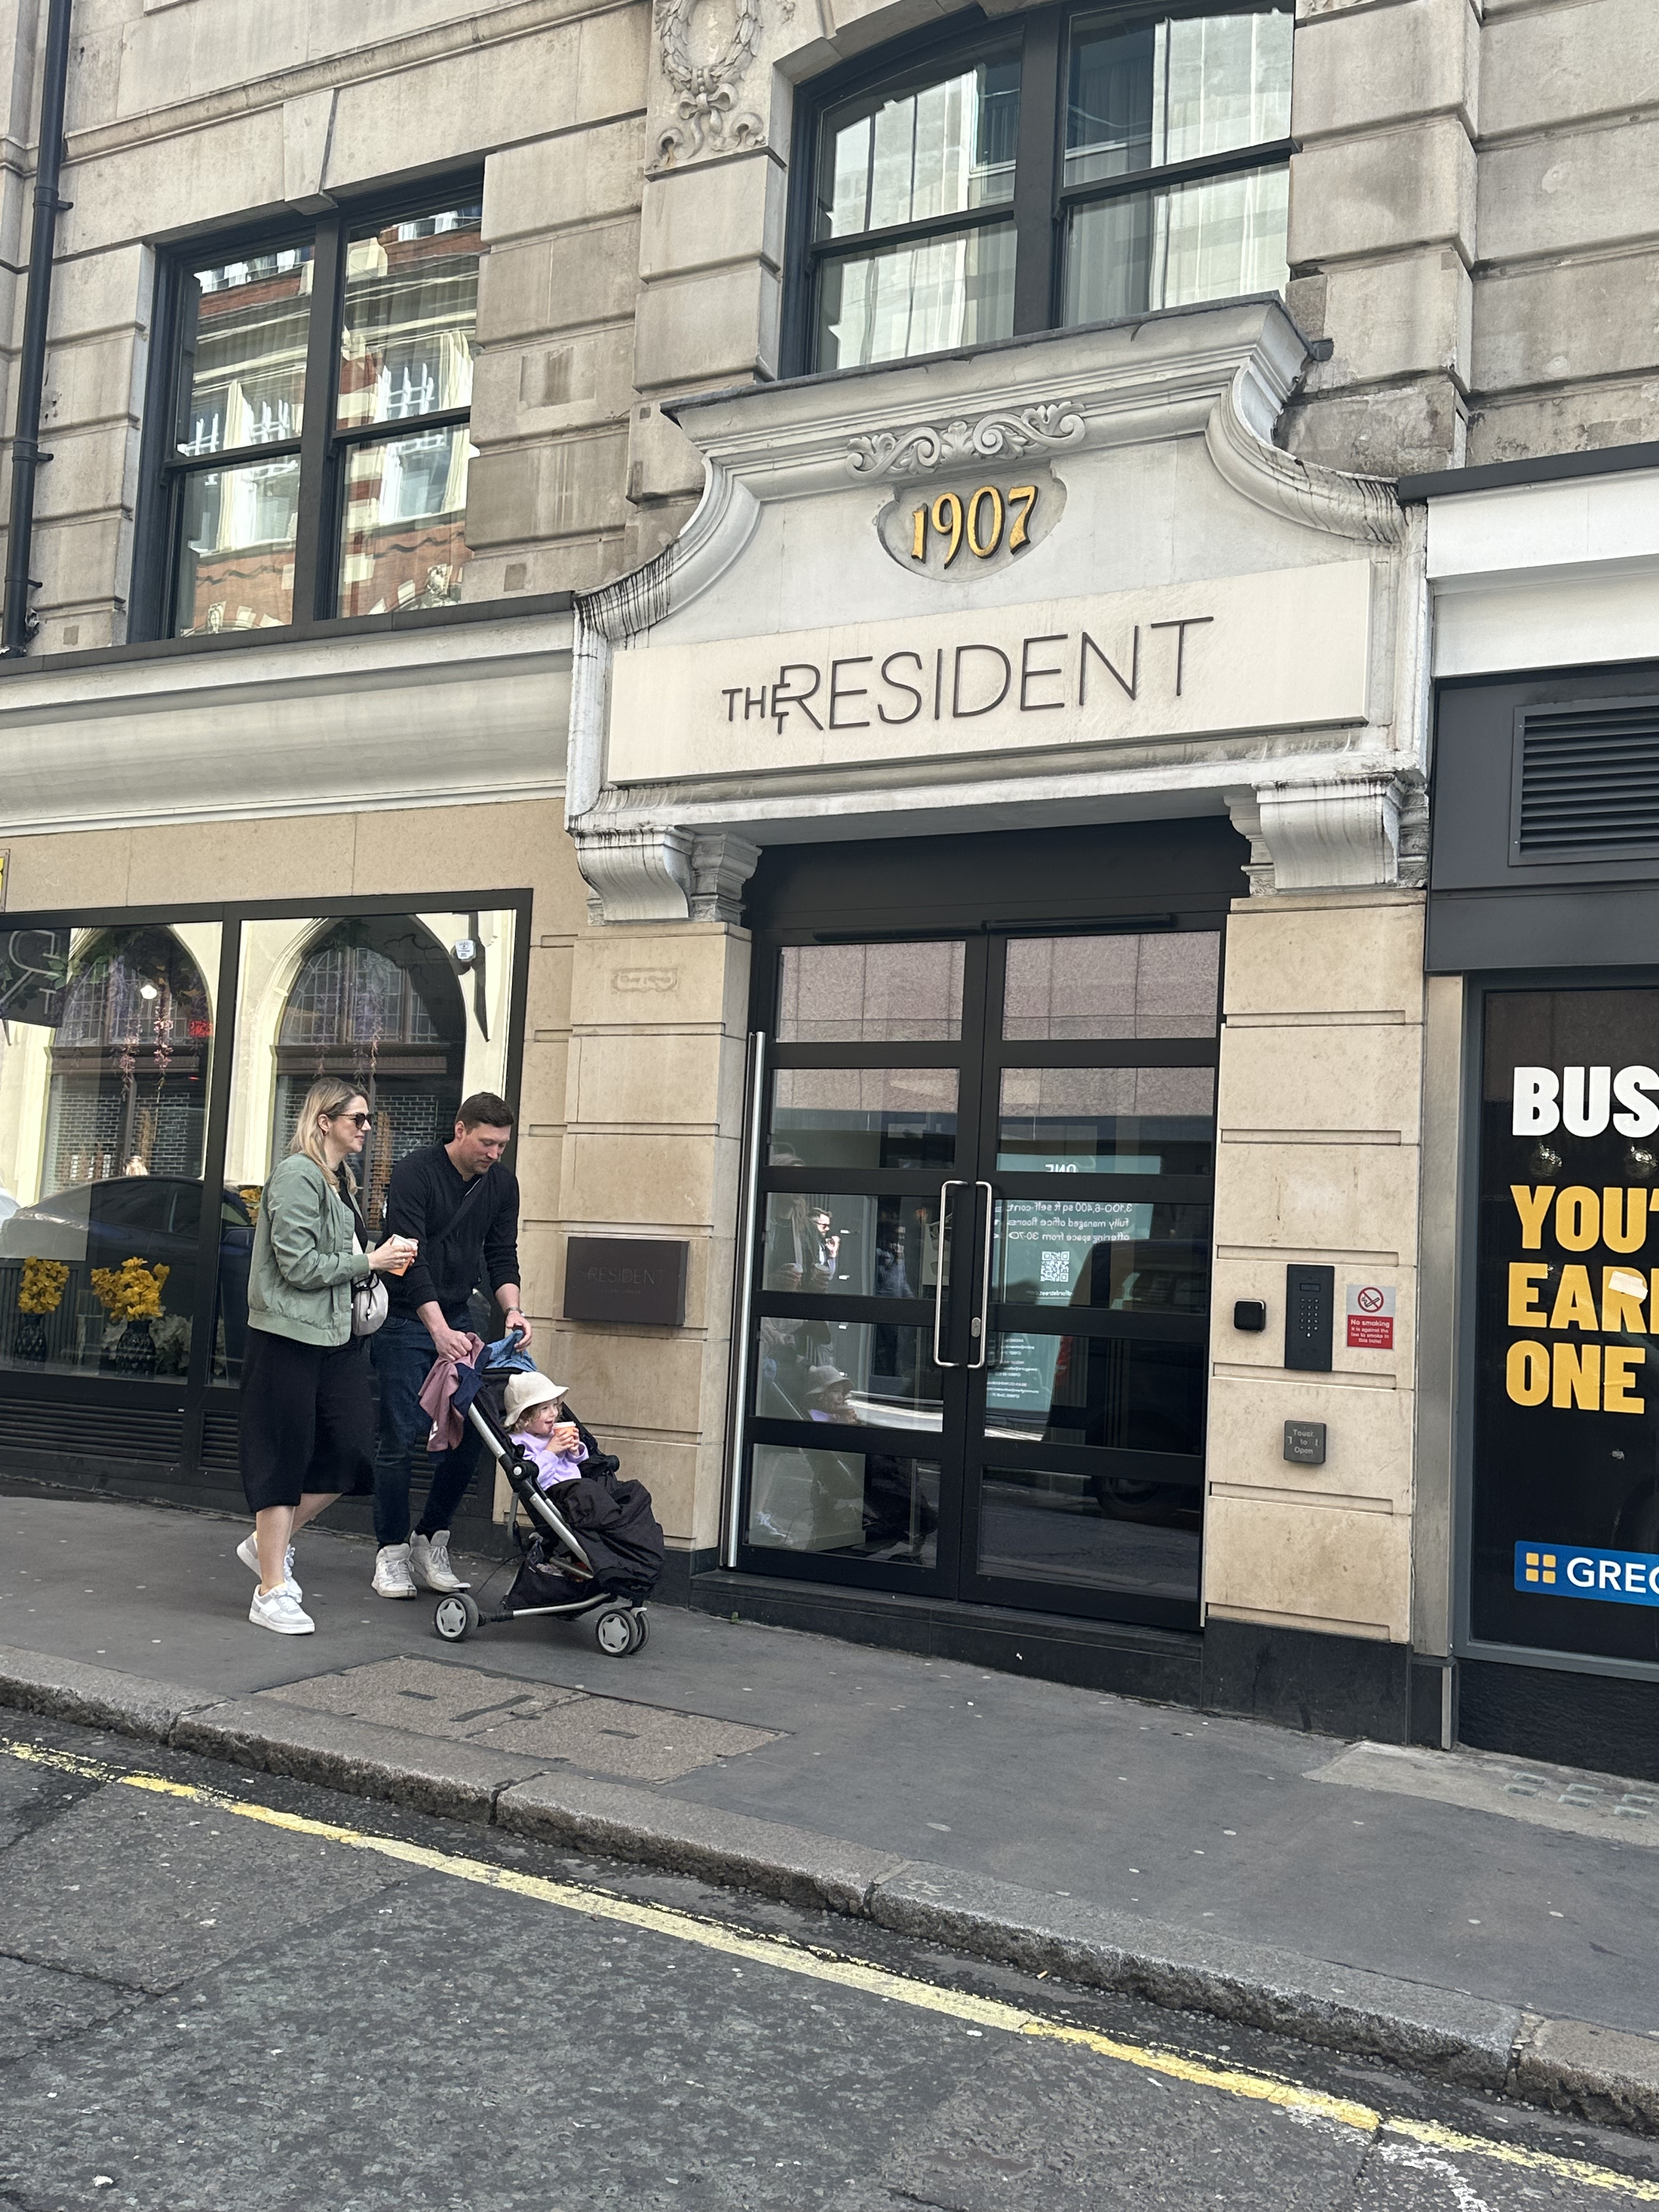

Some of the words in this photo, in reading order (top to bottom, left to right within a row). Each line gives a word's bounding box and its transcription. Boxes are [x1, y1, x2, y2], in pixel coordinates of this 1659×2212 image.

[911, 484, 1039, 570] 1907
[721, 682, 791, 721] THE
[771, 616, 1215, 735] RESIDENT
[587, 1266, 666, 1284] RESIDENT
[1508, 1262, 1659, 1334] EAR
[1362, 1320, 1390, 1328] smoking
[1505, 1339, 1645, 1414] ONE
[1293, 1429, 1315, 1437] Touch
[1294, 1446, 1314, 1455] Open
